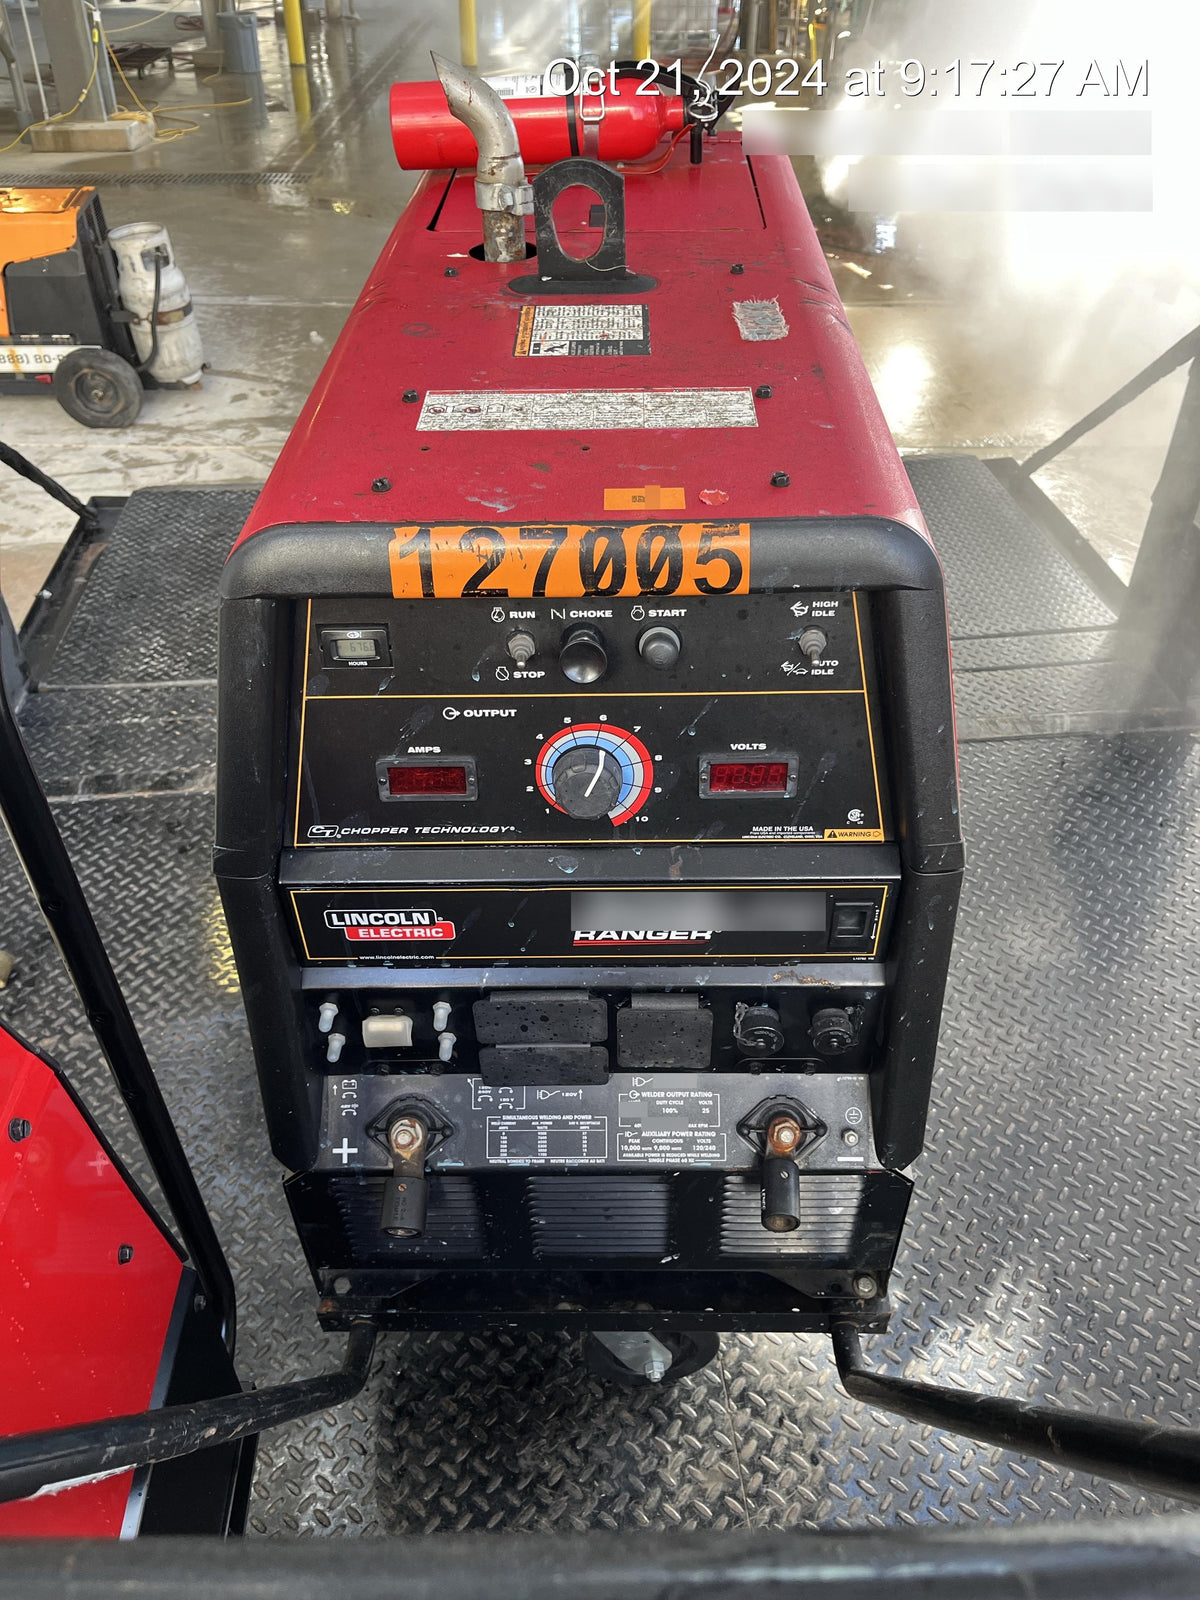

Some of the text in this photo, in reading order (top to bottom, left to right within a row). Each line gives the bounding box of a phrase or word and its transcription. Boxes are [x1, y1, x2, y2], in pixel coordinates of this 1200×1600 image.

[509, 610, 536, 619] RUN
[569, 610, 613, 618] CHOKE
[648, 608, 688, 618] START
[513, 670, 546, 679] STOP
[463, 708, 518, 718] OUTPUT
[563, 716, 572, 724] 5
[654, 754, 662, 762] 8
[340, 827, 408, 835] CHOPPER
[331, 912, 430, 926] LINCOLN
[358, 928, 444, 938] ELECTRIC
